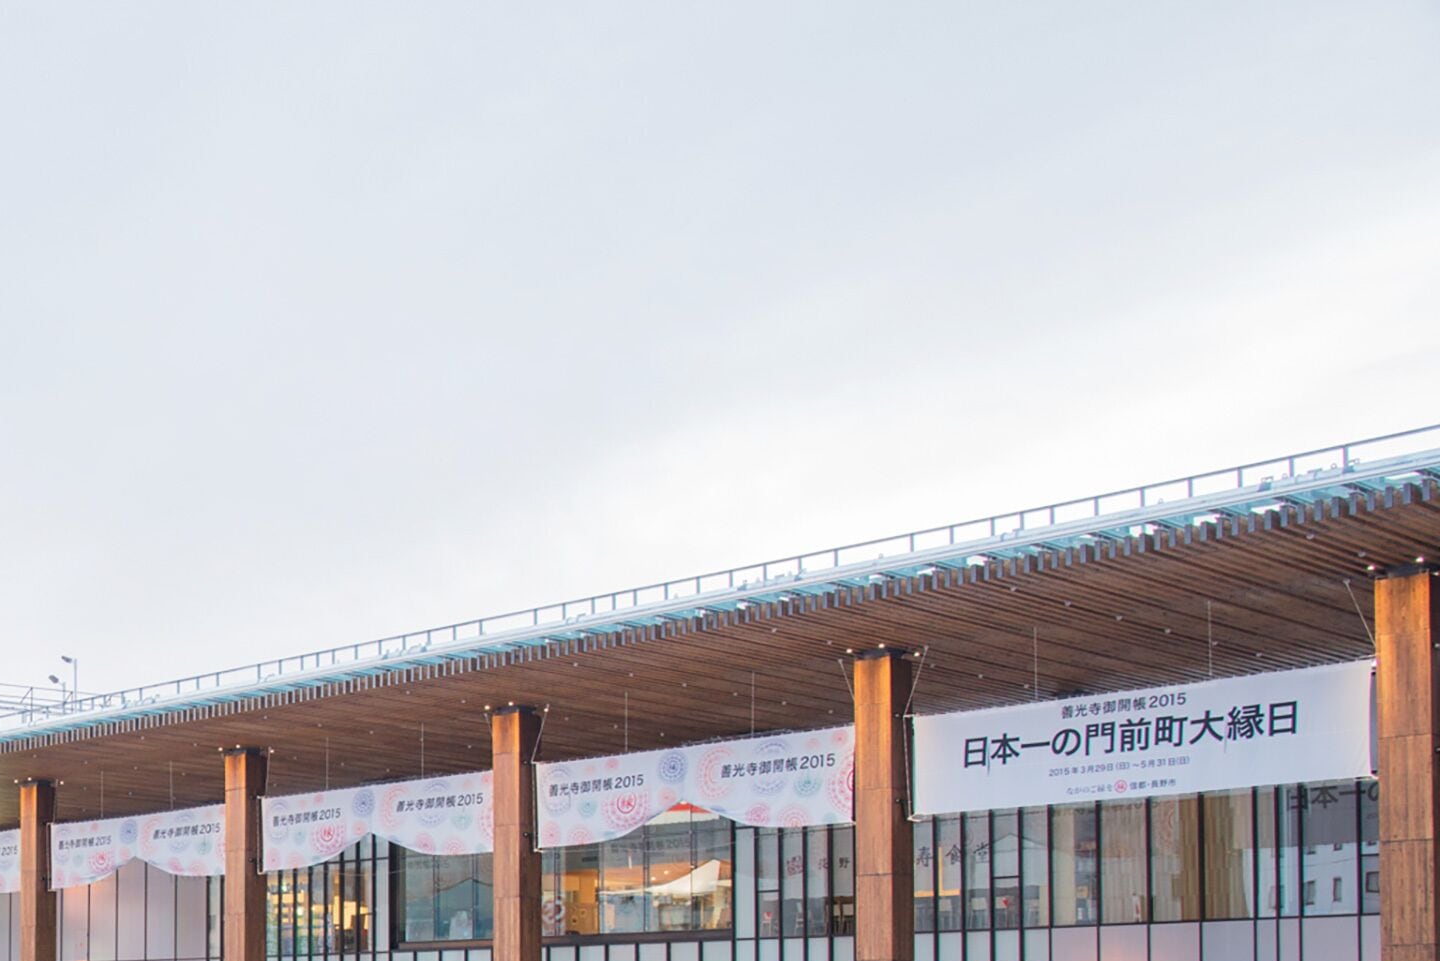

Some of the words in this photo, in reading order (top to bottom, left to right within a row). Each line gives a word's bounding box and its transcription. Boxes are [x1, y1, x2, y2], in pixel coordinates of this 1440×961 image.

[1061, 692, 1187, 719] 善光寺御開帳2015
[963, 700, 1298, 768] 日本一の門前町大縁日
[720, 753, 836, 779] 善光寺御開帳2015
[549, 774, 644, 797] 善光寺御開帳2015
